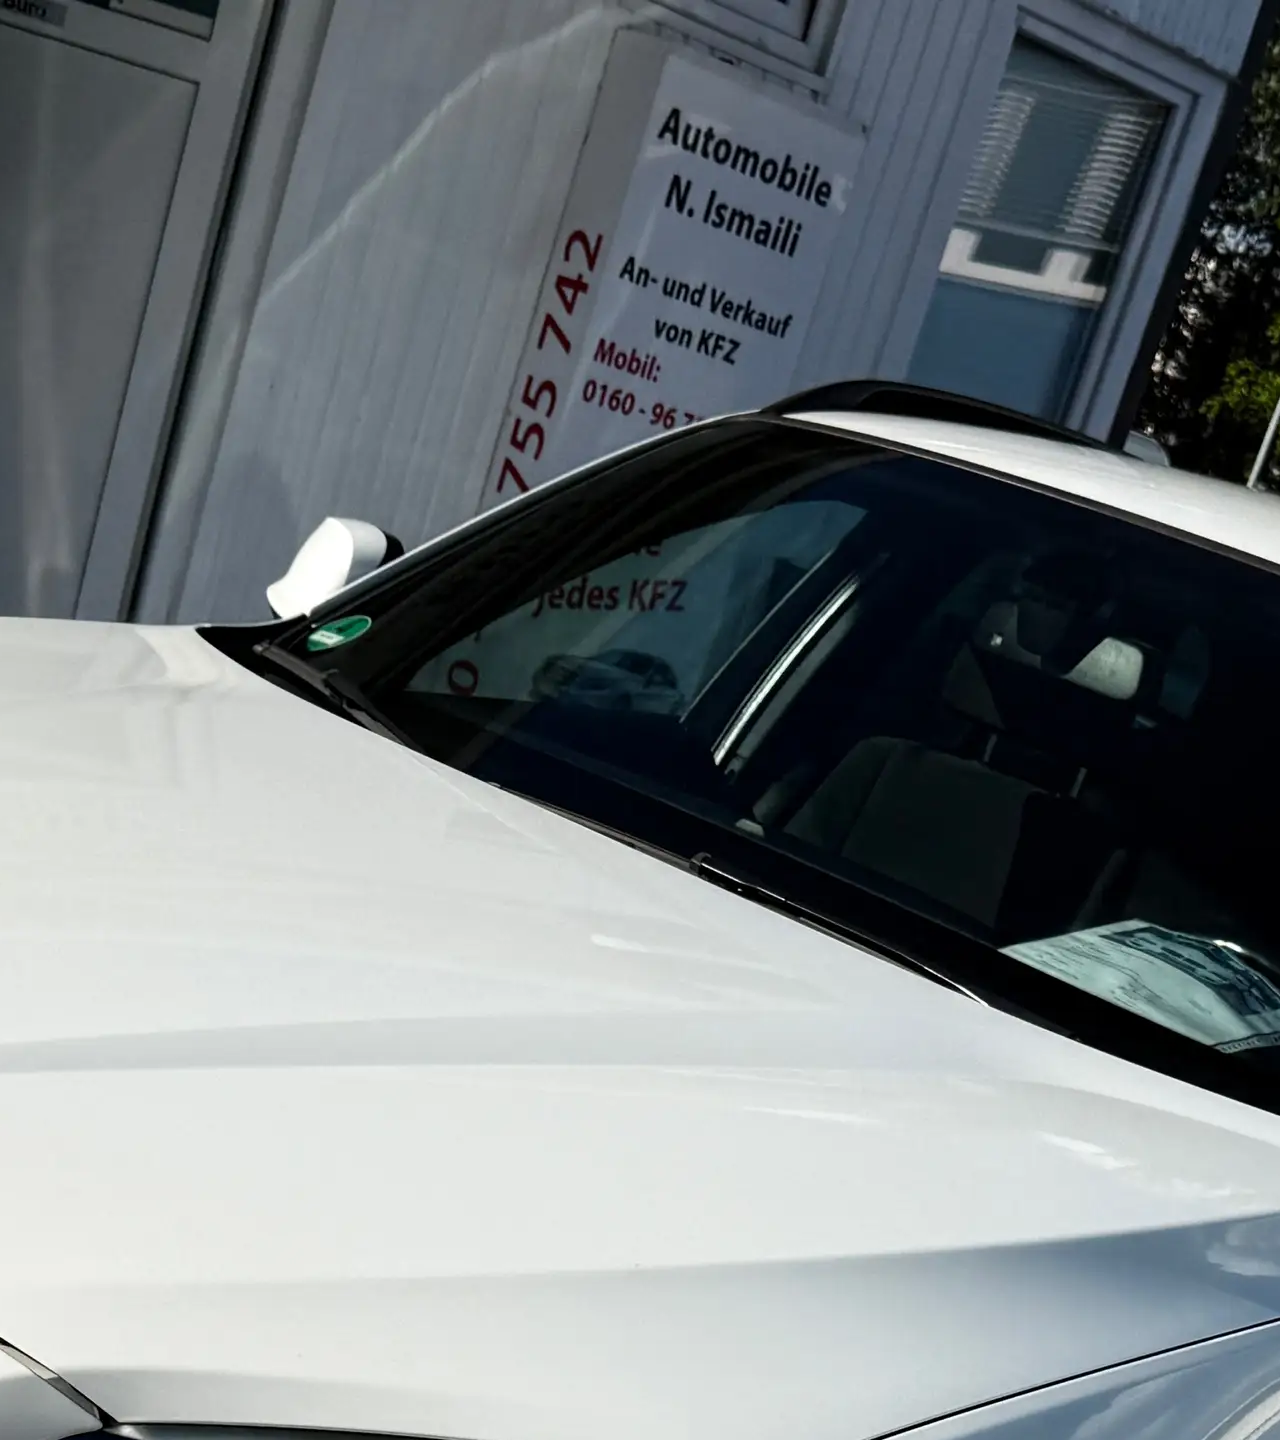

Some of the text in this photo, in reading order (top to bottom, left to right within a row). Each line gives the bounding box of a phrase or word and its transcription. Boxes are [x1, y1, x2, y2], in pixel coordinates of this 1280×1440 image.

[657, 107, 833, 208] Automobile
[664, 174, 803, 258] N. Ismaili
[620, 256, 794, 339] An- und Verkauf
[496, 229, 603, 493] 755 742
[594, 338, 662, 383] Mobil:
[654, 318, 742, 366] von KFZ
[582, 379, 636, 416] 0160
[650, 403, 677, 430] 96
[628, 579, 688, 612] KFZ
